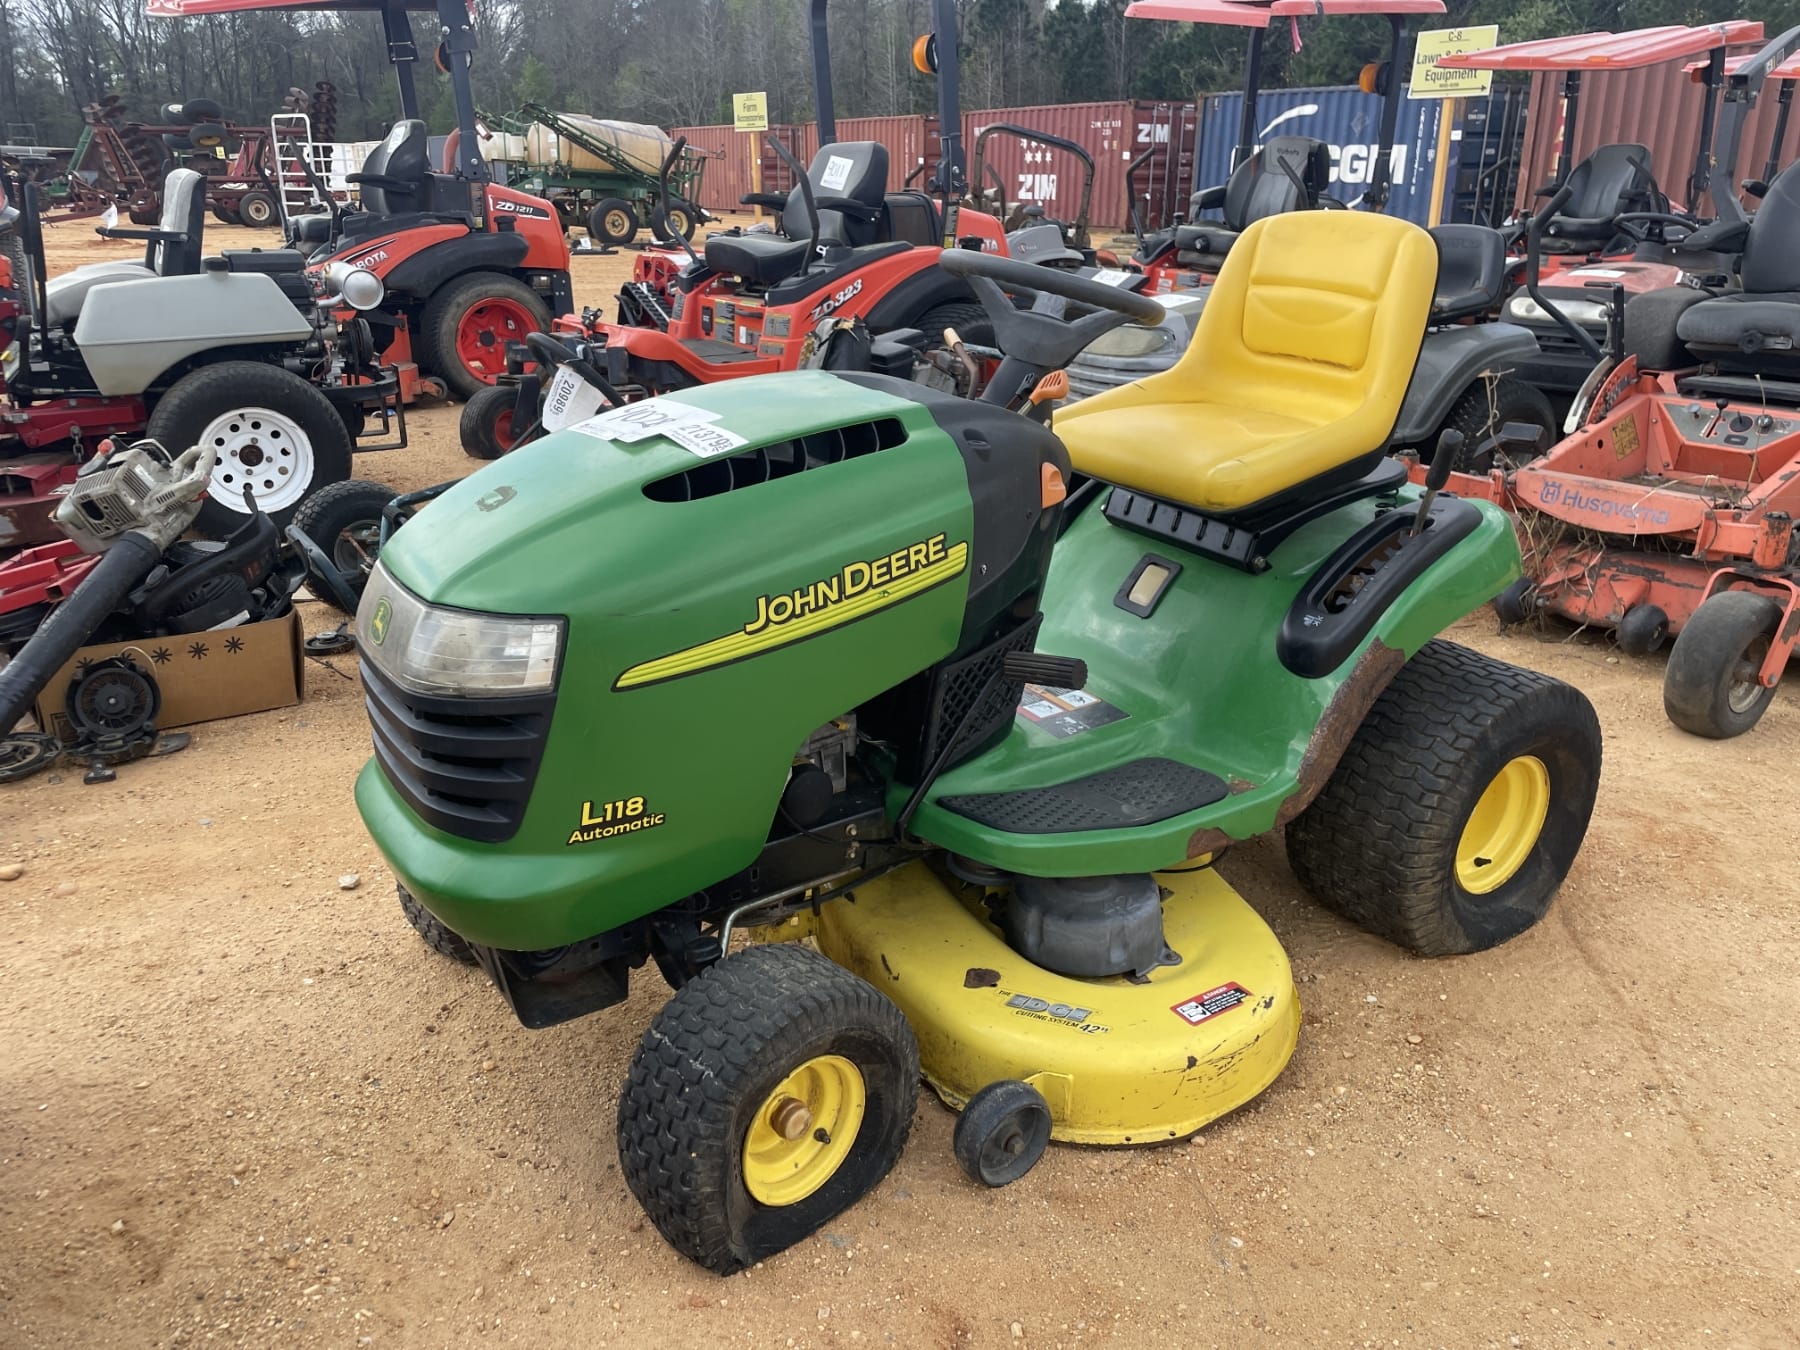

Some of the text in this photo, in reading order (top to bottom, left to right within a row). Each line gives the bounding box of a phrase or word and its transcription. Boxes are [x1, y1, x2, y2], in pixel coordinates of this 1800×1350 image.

[1425, 67, 1477, 82] Equipment
[1137, 123, 1169, 143] ZIM
[1018, 174, 1057, 200] ZIM
[353, 251, 388, 269] BOTA
[812, 278, 863, 322] ZD323
[553, 380, 575, 414] 20989
[1562, 491, 1669, 525] Husqvarna
[745, 533, 946, 634] JOHN DEERE
[581, 796, 644, 827] L118
[568, 814, 665, 844] Automatic
[1005, 994, 1092, 1023] EDGE
[1016, 1010, 1047, 1021] CUTTING
[1048, 1017, 1079, 1028] SYSTEM
